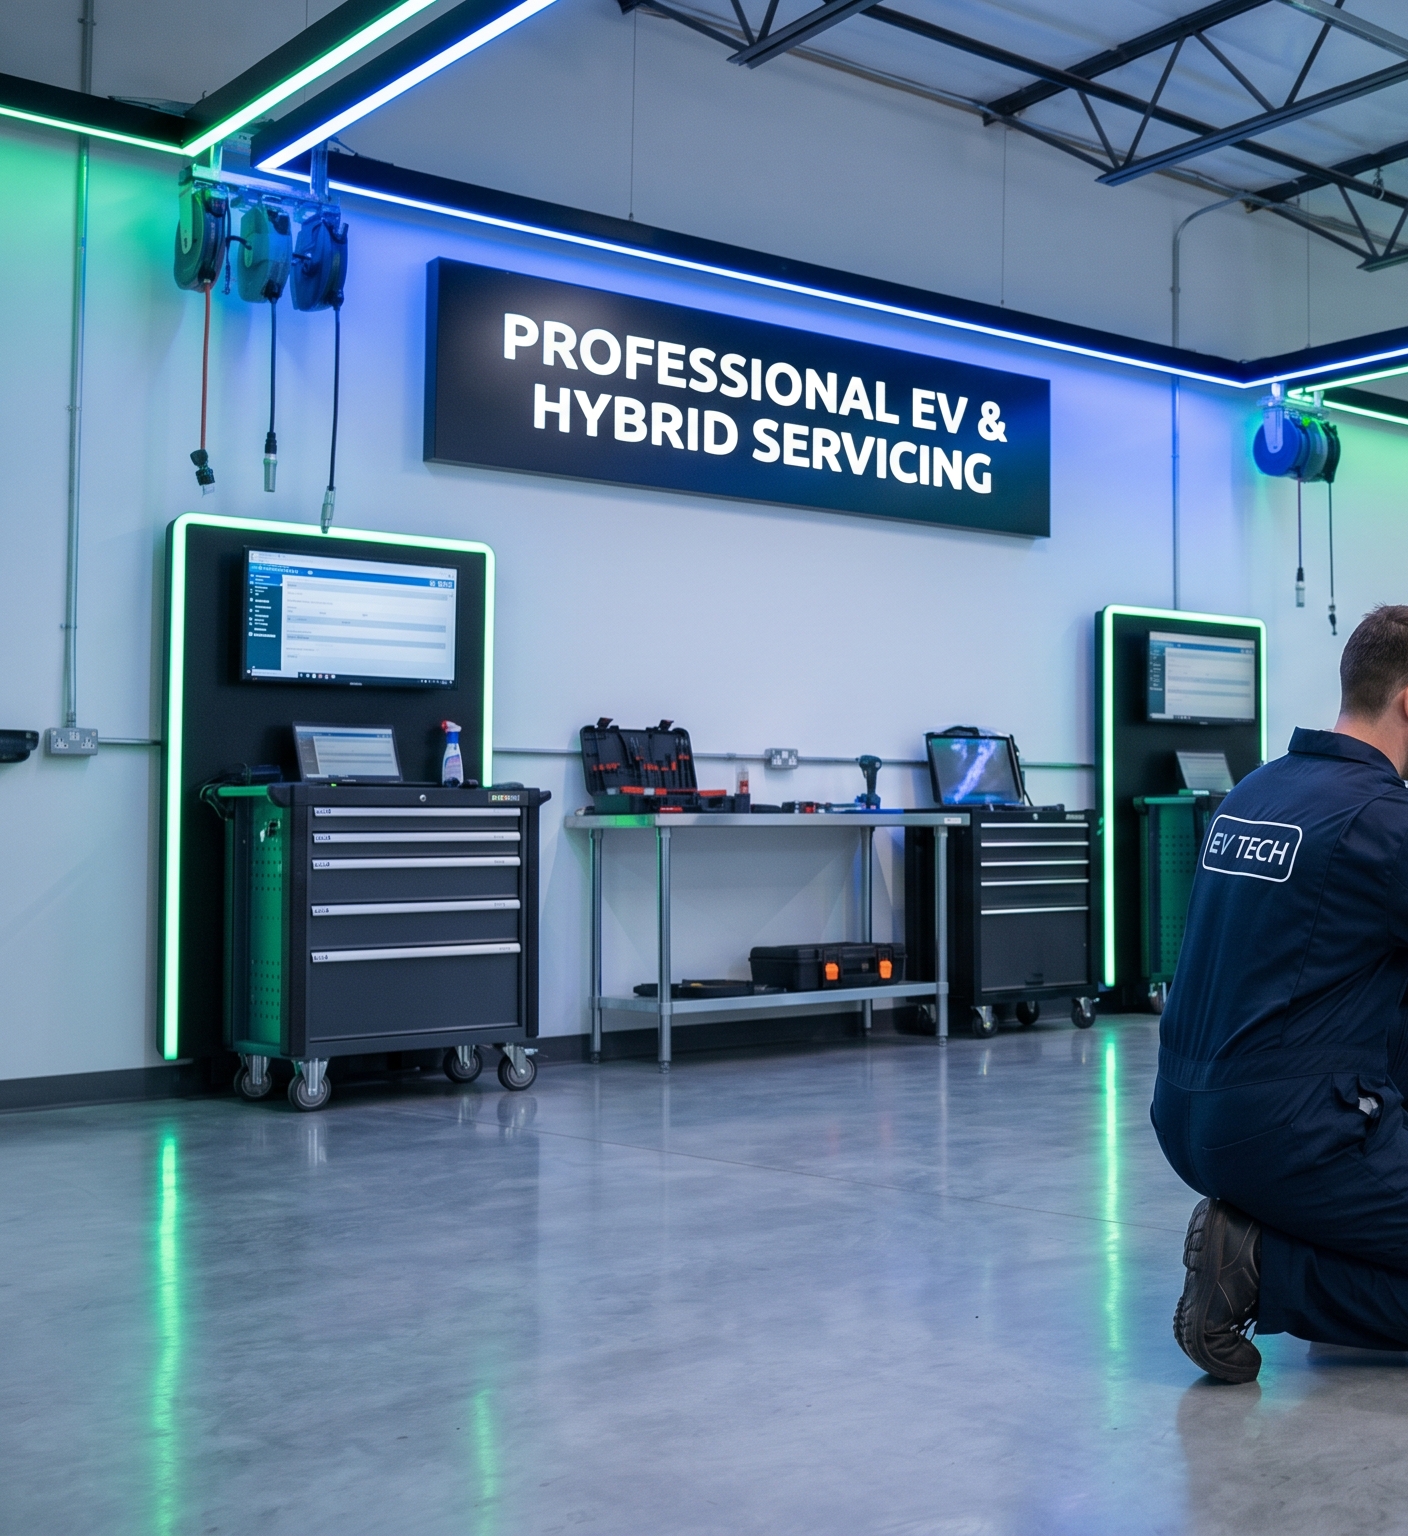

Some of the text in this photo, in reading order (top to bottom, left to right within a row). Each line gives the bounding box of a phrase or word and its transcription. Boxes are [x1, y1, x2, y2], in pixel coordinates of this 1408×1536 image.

[503, 312, 1008, 443] PROFESSIONAL EV &
[533, 382, 992, 495] HYBRID SERVICING
[1208, 832, 1290, 866] EV TECH
